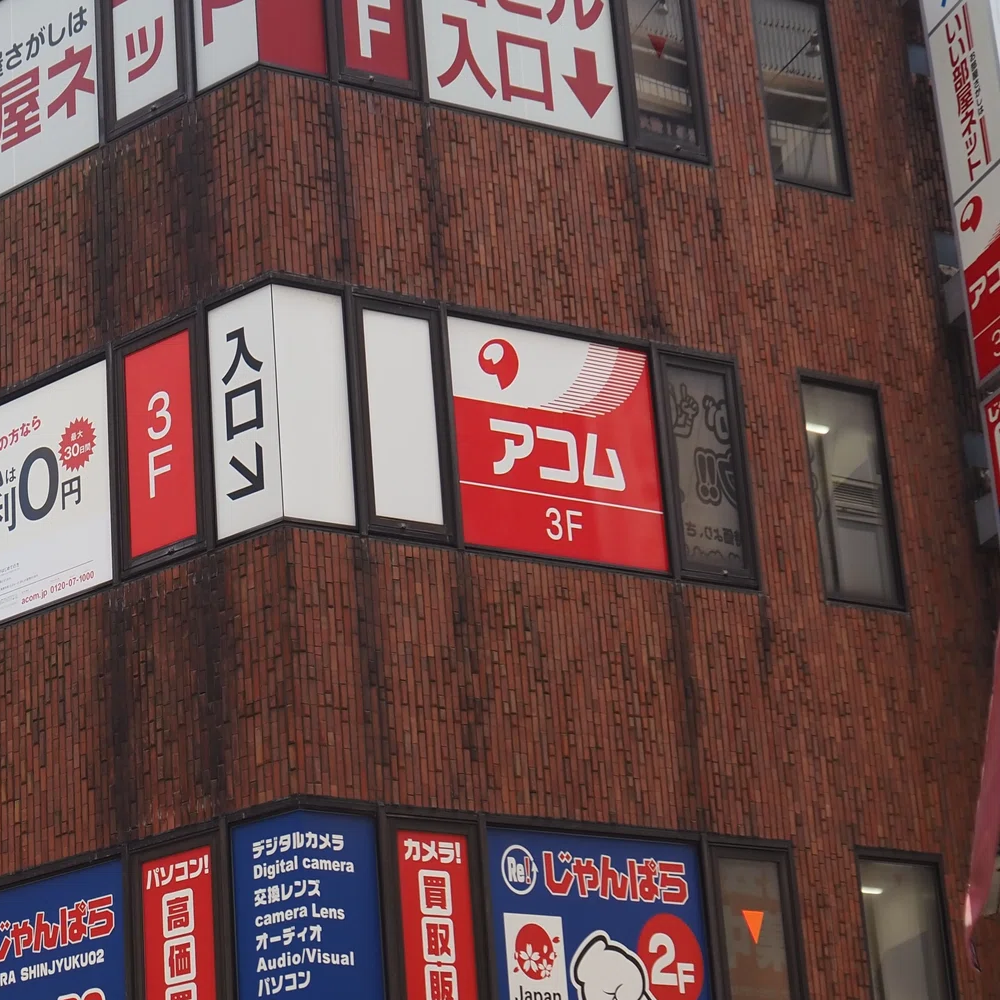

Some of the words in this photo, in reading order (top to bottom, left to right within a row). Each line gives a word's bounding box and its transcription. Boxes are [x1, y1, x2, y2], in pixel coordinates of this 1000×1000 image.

[437, 13, 554, 111] 入口
[945, 14, 981, 182] いい部屋ネット
[221, 326, 264, 441] 入口
[70, 430, 83, 441] 最大
[64, 443, 91, 460] 30日間
[489, 418, 626, 491] アコム
[545, 507, 583, 542] 3F
[21, 589, 48, 605] acom.jp
[50, 571, 95, 594] 0120-07-1000
[252, 832, 345, 858] デジタルカメラ
[404, 838, 461, 865] カメラ!
[146, 855, 209, 890] パソコン!
[253, 857, 299, 880] Digital
[302, 856, 355, 874] camera
[542, 850, 689, 906] じゃんぱら
[254, 878, 321, 907] 交換レンズ
[254, 904, 308, 927] camera
[311, 901, 346, 921] Lens
[255, 924, 322, 951] オーディオ
[20, 949, 105, 982] SHINJYUKU02
[256, 947, 355, 973] Audio/Visual
[648, 932, 696, 993] 2F
[258, 971, 311, 997] パソコン
